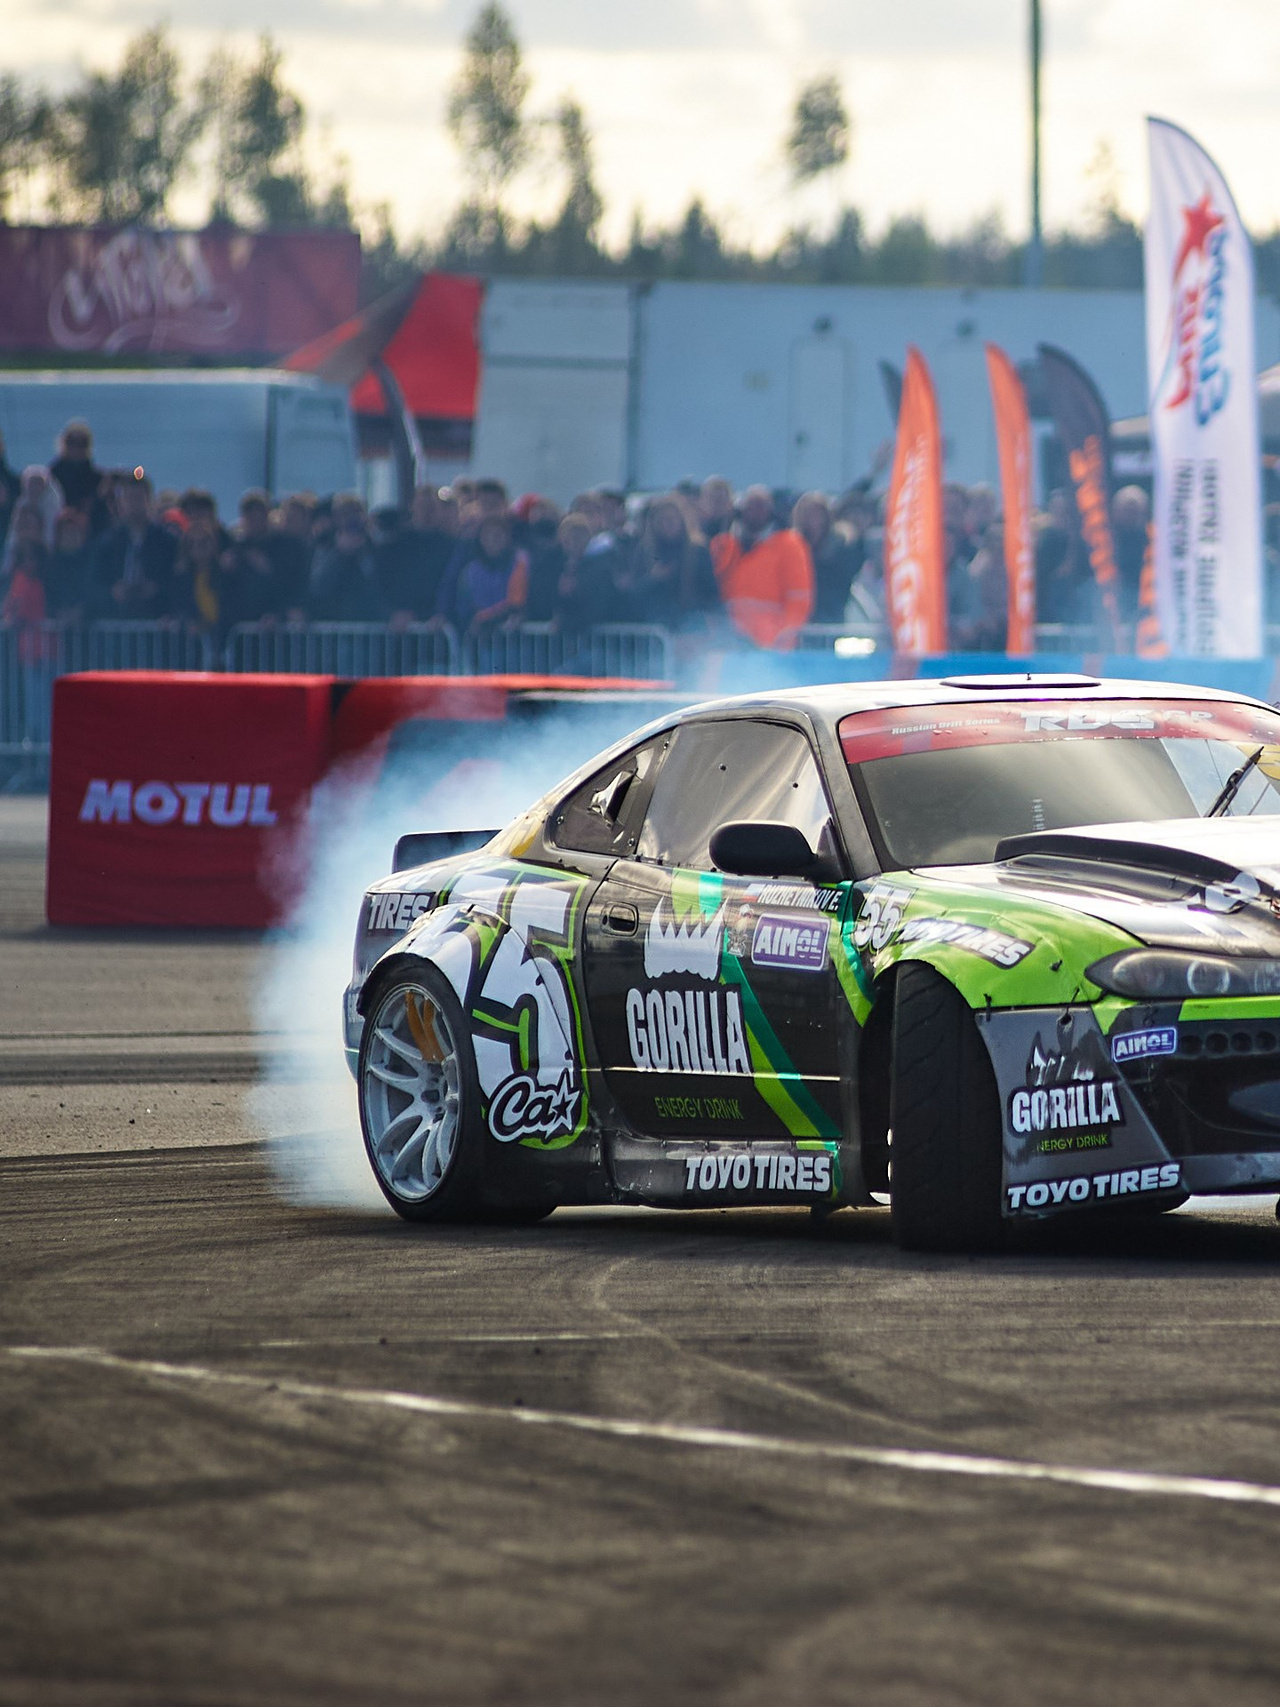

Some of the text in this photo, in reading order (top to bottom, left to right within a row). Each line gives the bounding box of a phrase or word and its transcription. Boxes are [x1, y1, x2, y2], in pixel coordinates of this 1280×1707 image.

[891, 723, 937, 735] Russian
[1021, 709, 1156, 732] RDS
[78, 779, 279, 827] MOTUL
[367, 893, 431, 931] TIRES
[853, 882, 915, 950] 55
[754, 925, 822, 960] AIMOL
[626, 987, 752, 1076] GORILLA
[654, 1096, 745, 1121] ENERGY DRINK
[1011, 1082, 1121, 1133] GORILLA
[1076, 1133, 1109, 1149] DRINK
[686, 1155, 831, 1193] TOYO TIRES
[1007, 1163, 1181, 1209] TOYO TIRES
